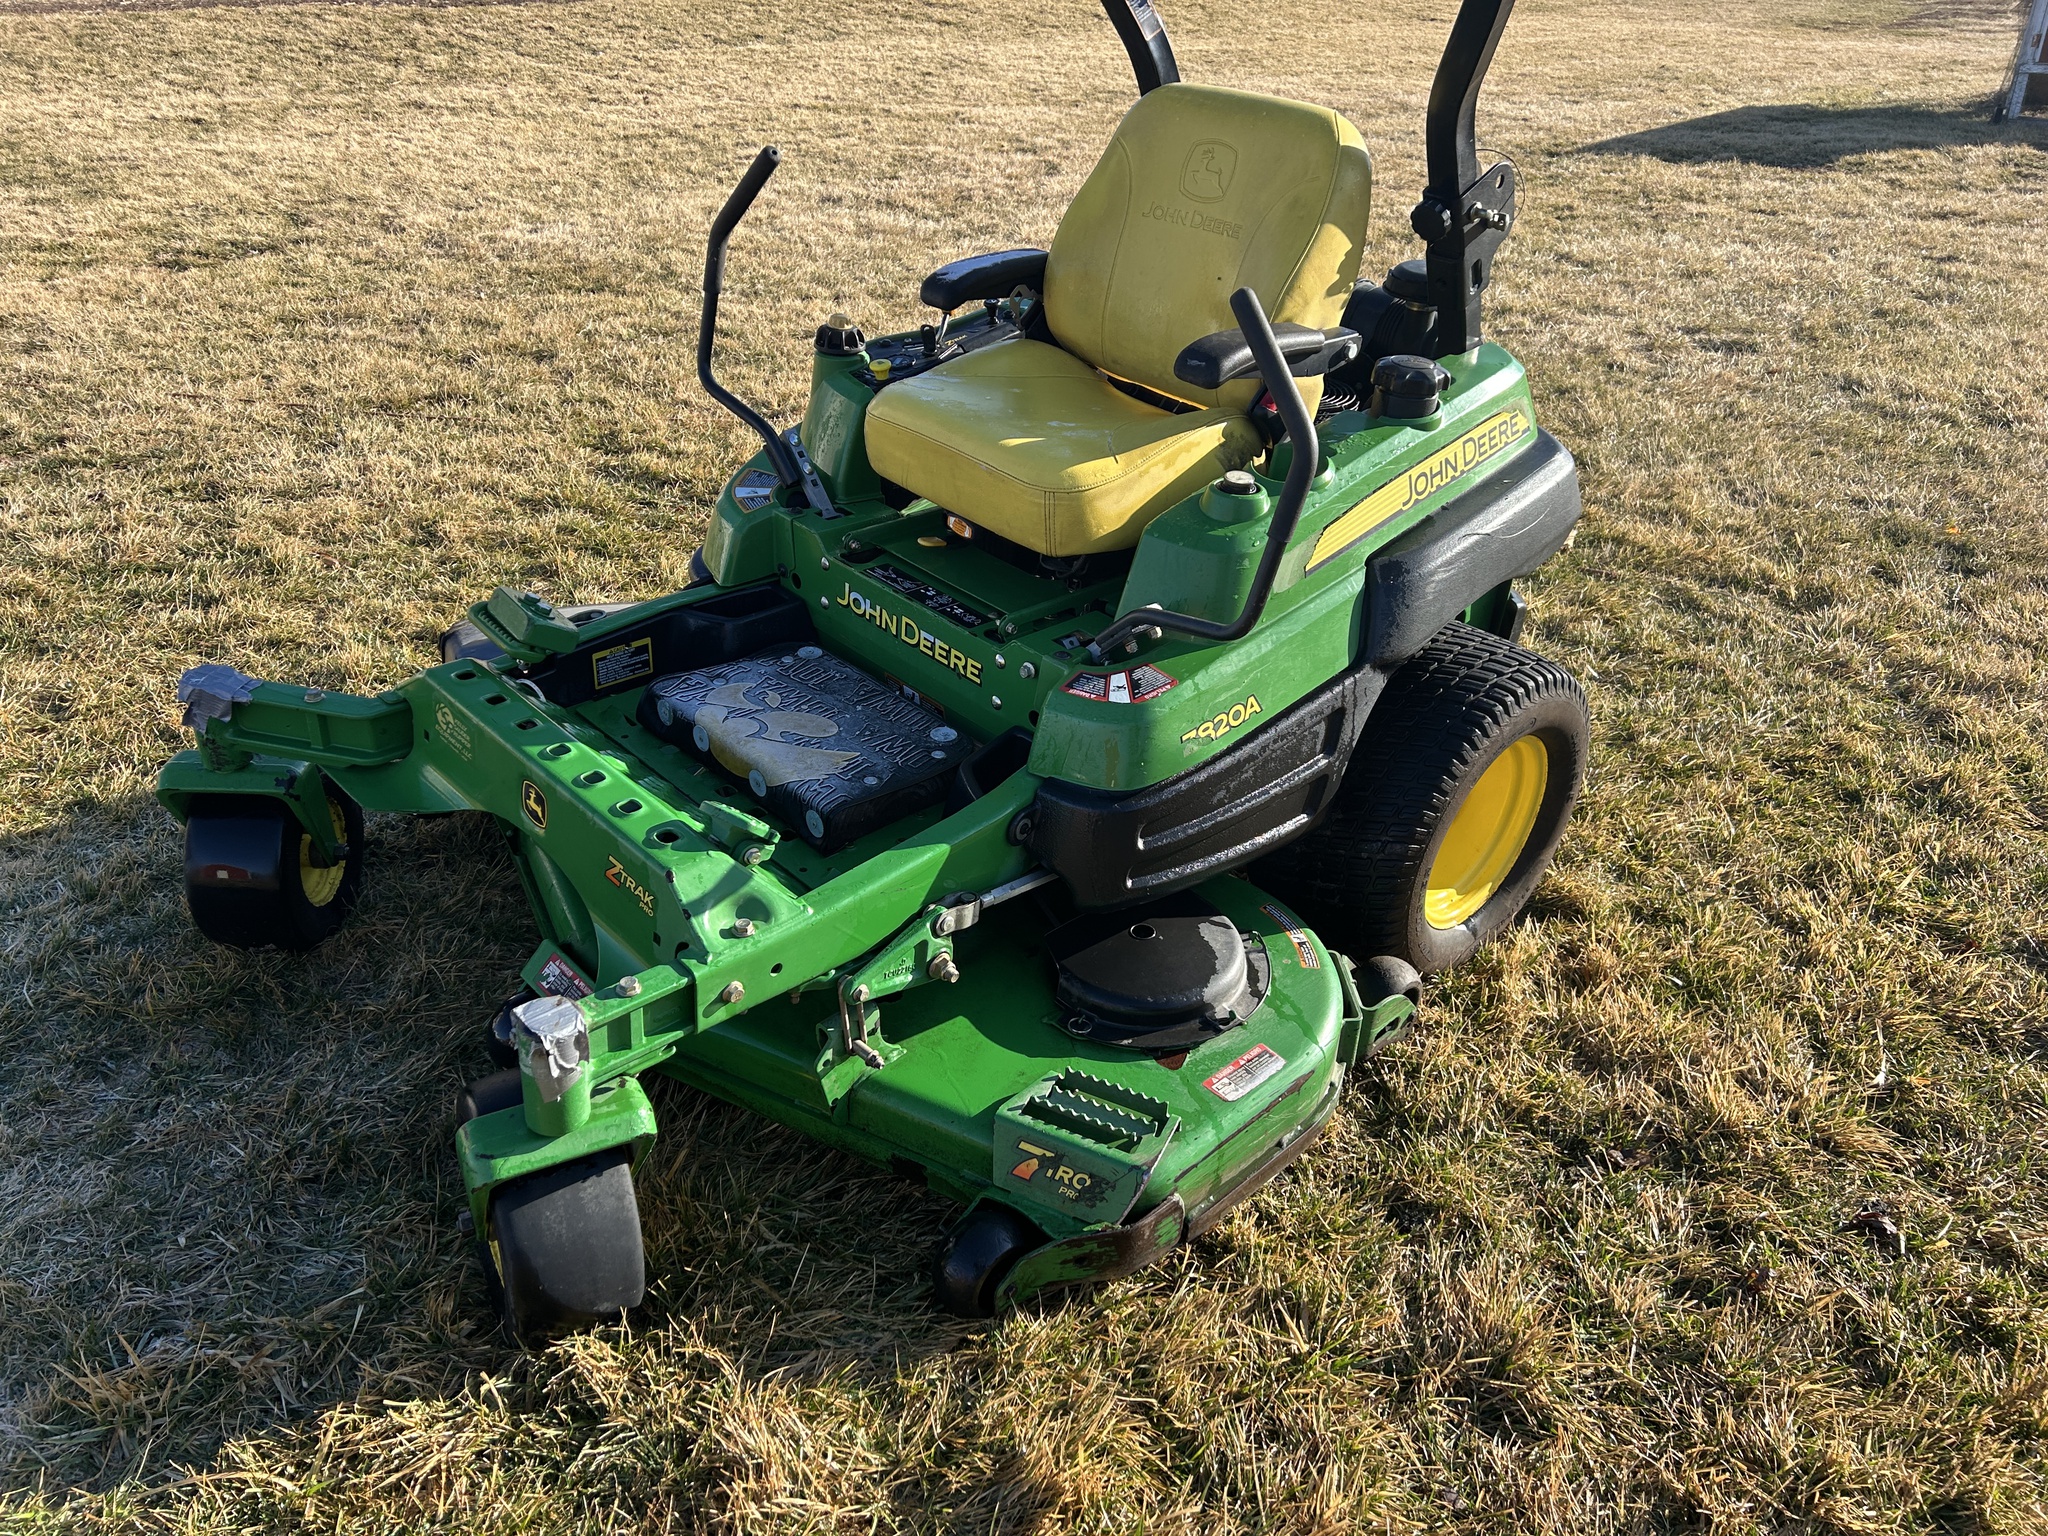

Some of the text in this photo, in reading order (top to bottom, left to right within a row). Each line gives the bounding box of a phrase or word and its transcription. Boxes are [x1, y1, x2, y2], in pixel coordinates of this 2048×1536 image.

[1142, 201, 1243, 240] JOHN DEERE
[1402, 413, 1522, 509] JOHN DEERE
[836, 582, 983, 685] JOHN DEERE
[605, 855, 654, 909] ZTRAK
[639, 901, 654, 917] PRO
